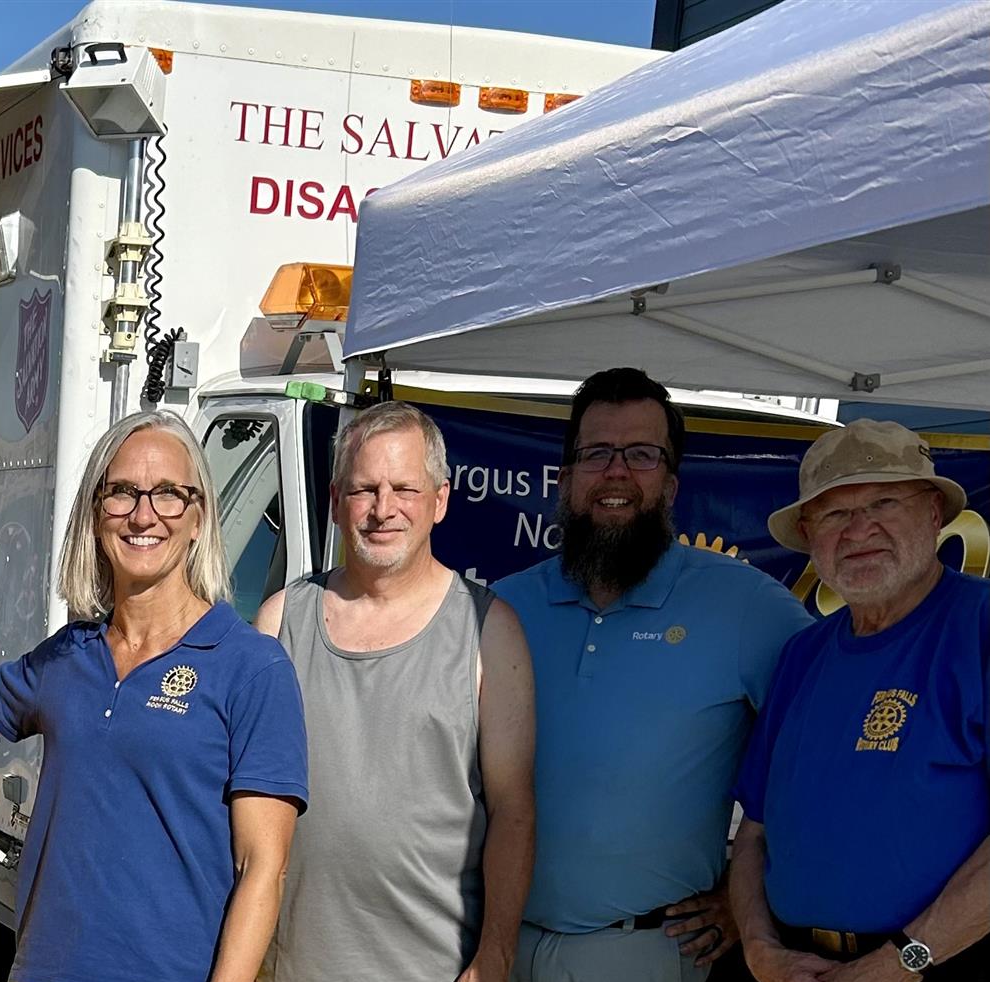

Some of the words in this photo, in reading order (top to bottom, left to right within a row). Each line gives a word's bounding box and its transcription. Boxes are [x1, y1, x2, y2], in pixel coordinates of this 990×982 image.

[230, 101, 325, 151] THE
[340, 114, 506, 162] SALVA
[249, 176, 380, 224] DISA
[447, 464, 531, 502] rgus
[632, 631, 663, 641] Rotary
[897, 689, 918, 707] FALLS
